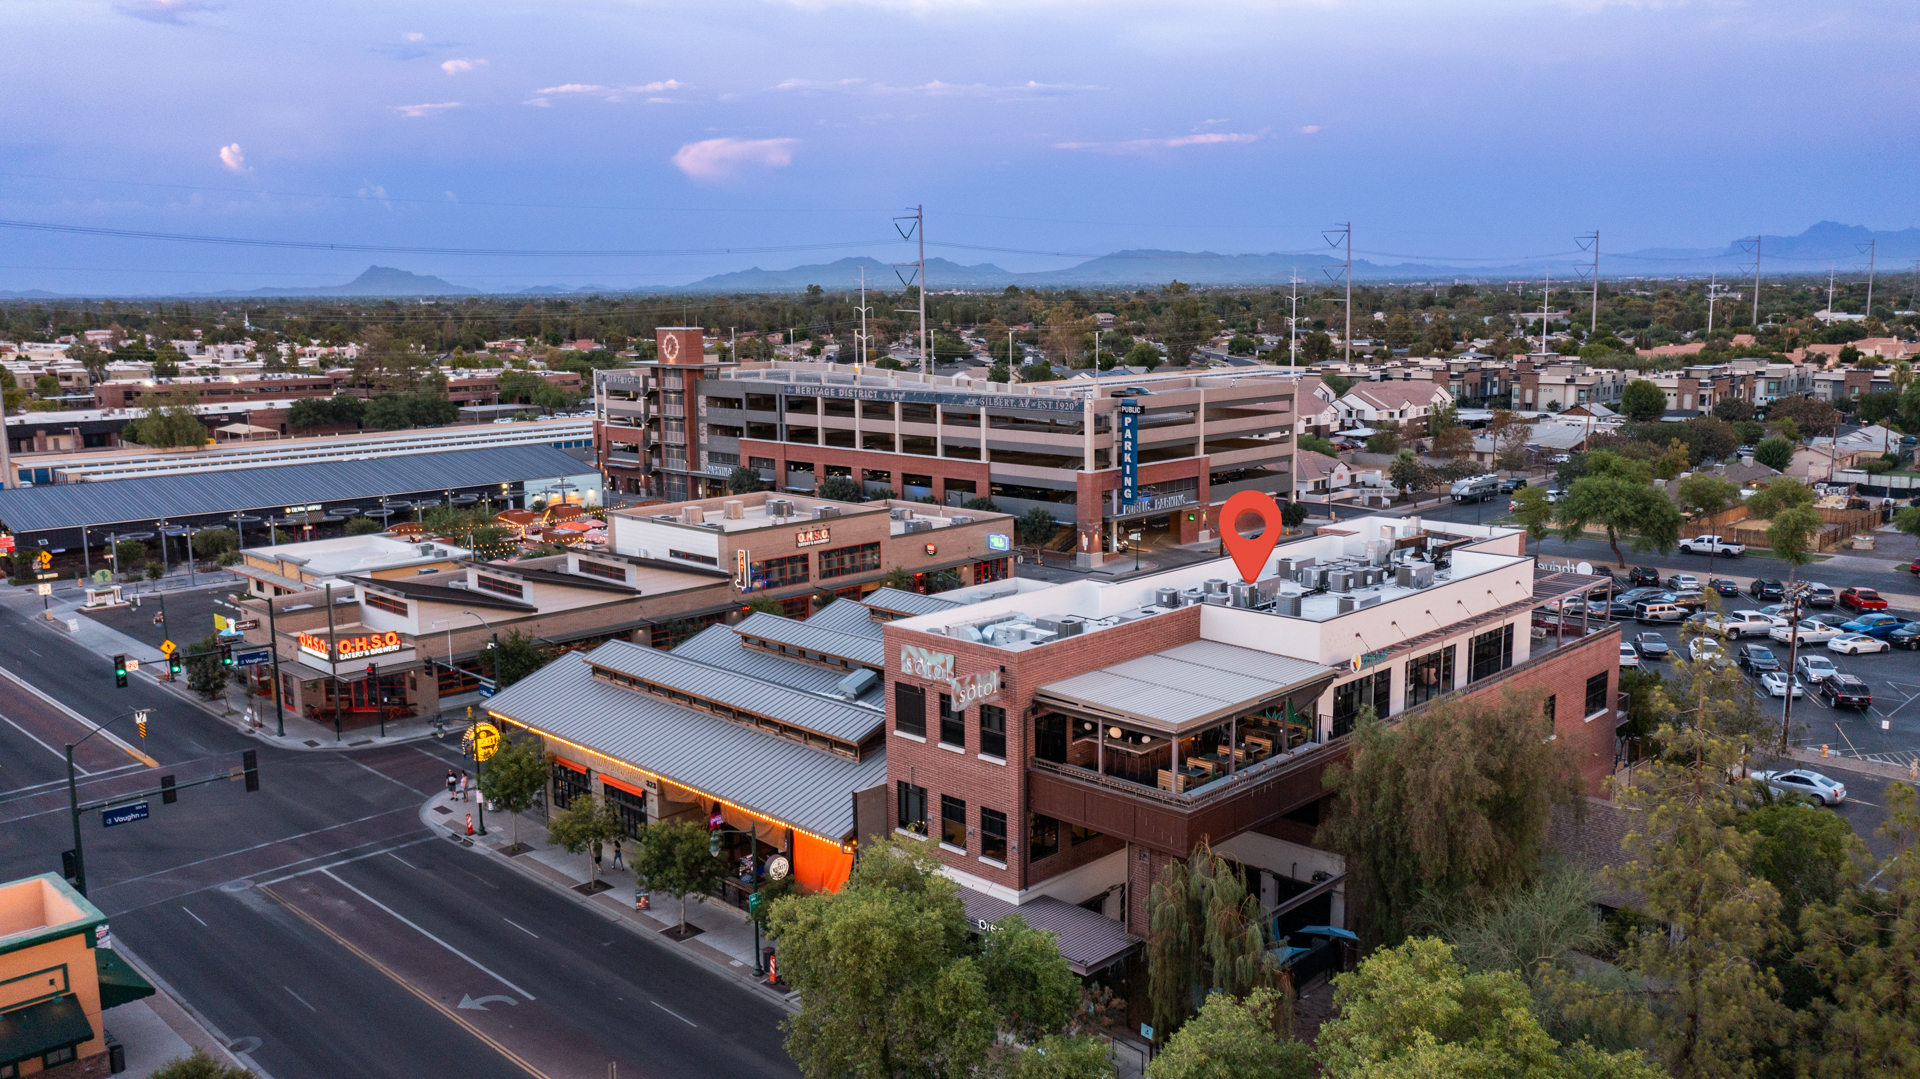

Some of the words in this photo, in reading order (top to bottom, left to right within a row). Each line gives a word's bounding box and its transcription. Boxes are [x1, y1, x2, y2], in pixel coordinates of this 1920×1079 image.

[795, 385, 835, 397] HERITAGE
[838, 387, 878, 399] DISTRICT
[1055, 402, 1075, 411] 1920
[1124, 416, 1132, 499] PARKING
[1123, 500, 1151, 515] PUBLIC
[1154, 494, 1186, 509] PARKING
[797, 529, 830, 543] O.H.S.O.
[299, 632, 328, 655] O.H.S.O.
[338, 631, 401, 654] O.H.S.O.
[340, 651, 364, 660] EATERY
[370, 645, 400, 655] BREWERY
[114, 813, 140, 822] Vaughn
